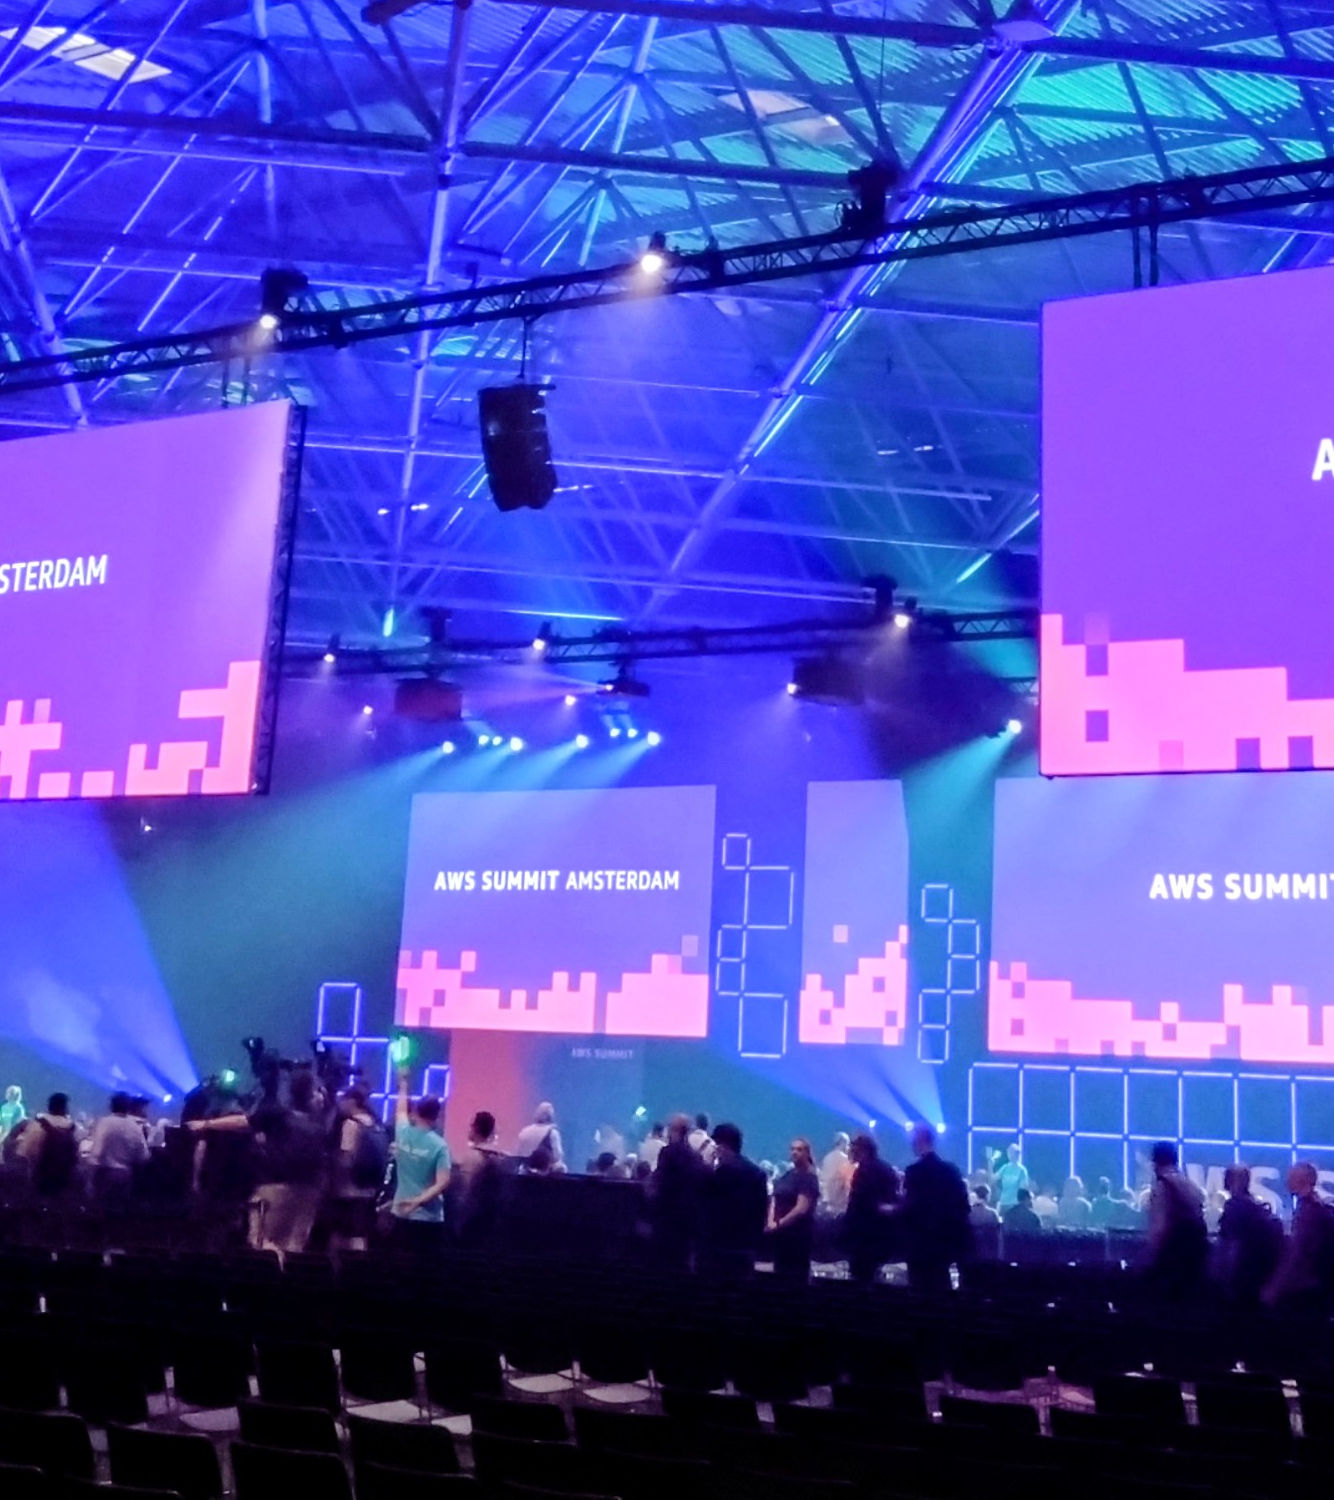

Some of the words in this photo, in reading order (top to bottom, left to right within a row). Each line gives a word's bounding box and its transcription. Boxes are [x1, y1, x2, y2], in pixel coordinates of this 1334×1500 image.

[434, 870, 476, 891] AWS
[481, 870, 560, 891] SUMMIT
[565, 870, 680, 891] AMSTERDAM
[1149, 873, 1214, 900] AWS
